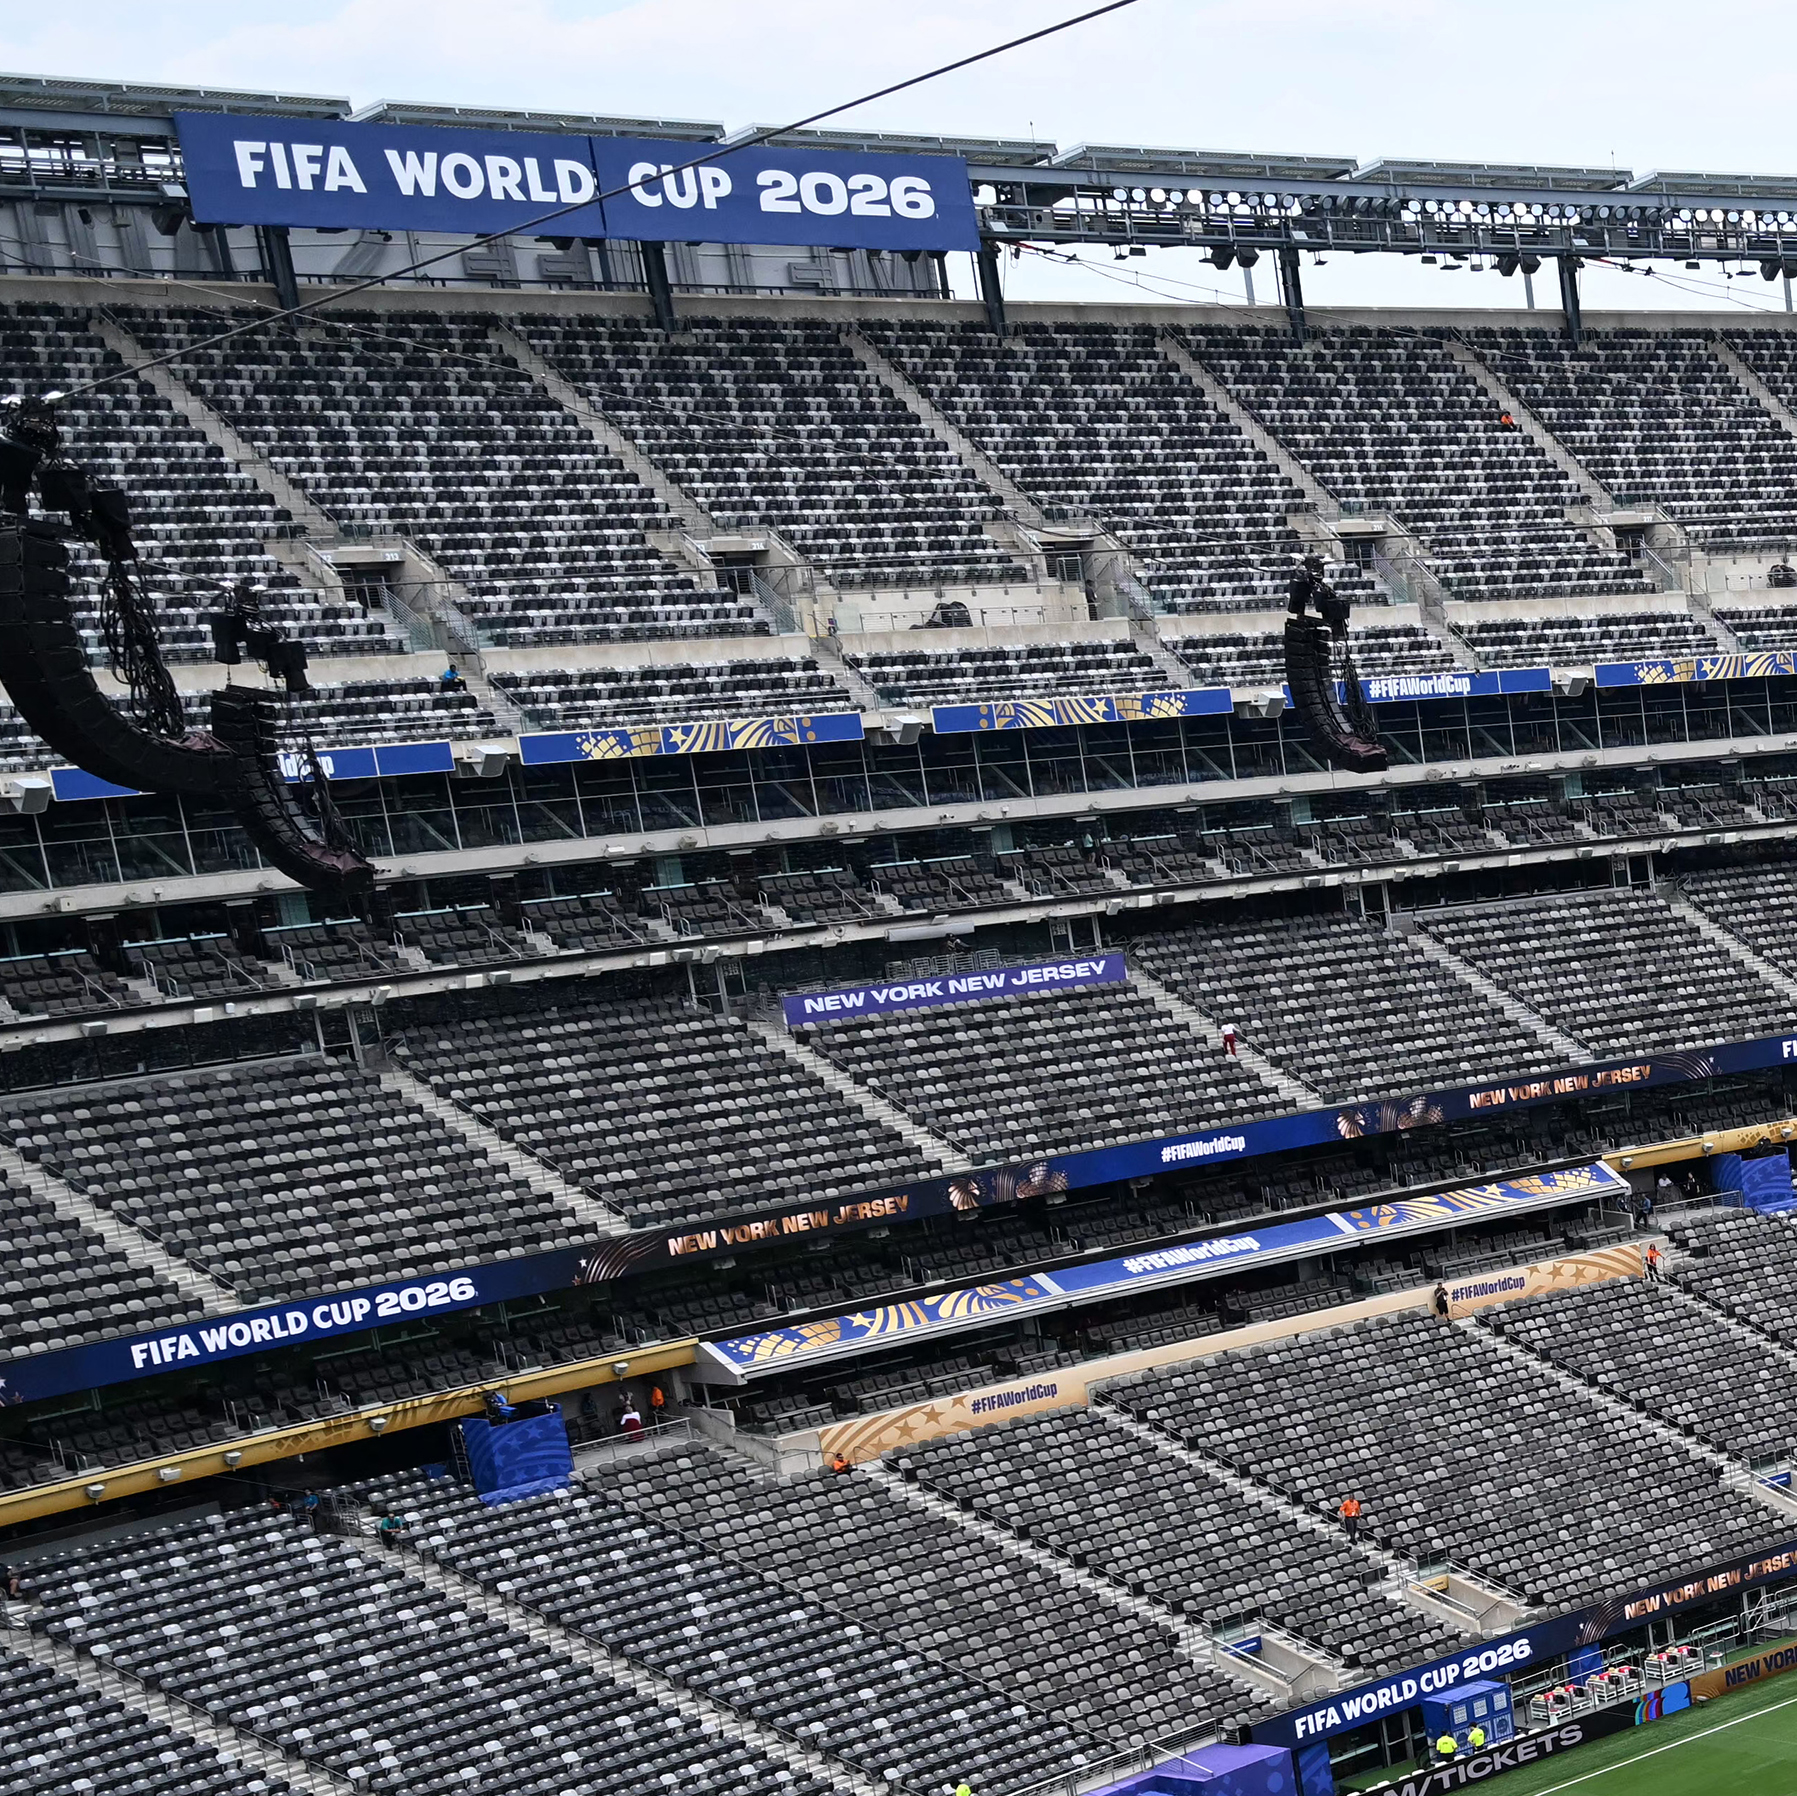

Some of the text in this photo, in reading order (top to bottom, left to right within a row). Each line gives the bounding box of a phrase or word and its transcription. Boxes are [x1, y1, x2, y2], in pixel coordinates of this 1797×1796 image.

[234, 141, 934, 218] FIFA WORLD CUP 2026
[1369, 677, 1471, 699] #FIFAWorldCup
[804, 960, 1105, 1013] NEW YORK NEW JERSEY
[1470, 1066, 1651, 1108] NEW YORK NEW JERSEY
[1161, 1136, 1245, 1162] #FIFAWorldCup
[668, 1196, 908, 1255] NEW YORK NEW JERSEY
[1123, 1236, 1261, 1273] #FIFAWorldCup
[1452, 1277, 1525, 1302] #FIFAWorldCup
[131, 1278, 475, 1368] FIFA WORLD CUP 2026
[971, 1383, 1058, 1414] #FIFAWorldCup
[1625, 1595, 1659, 1619] NEW
[1663, 1581, 1705, 1606] YORK
[1708, 1571, 1741, 1593] NEW
[1295, 1639, 1530, 1738] FIFA WORLD CUP 2026
[1725, 1662, 1764, 1687] NEW
